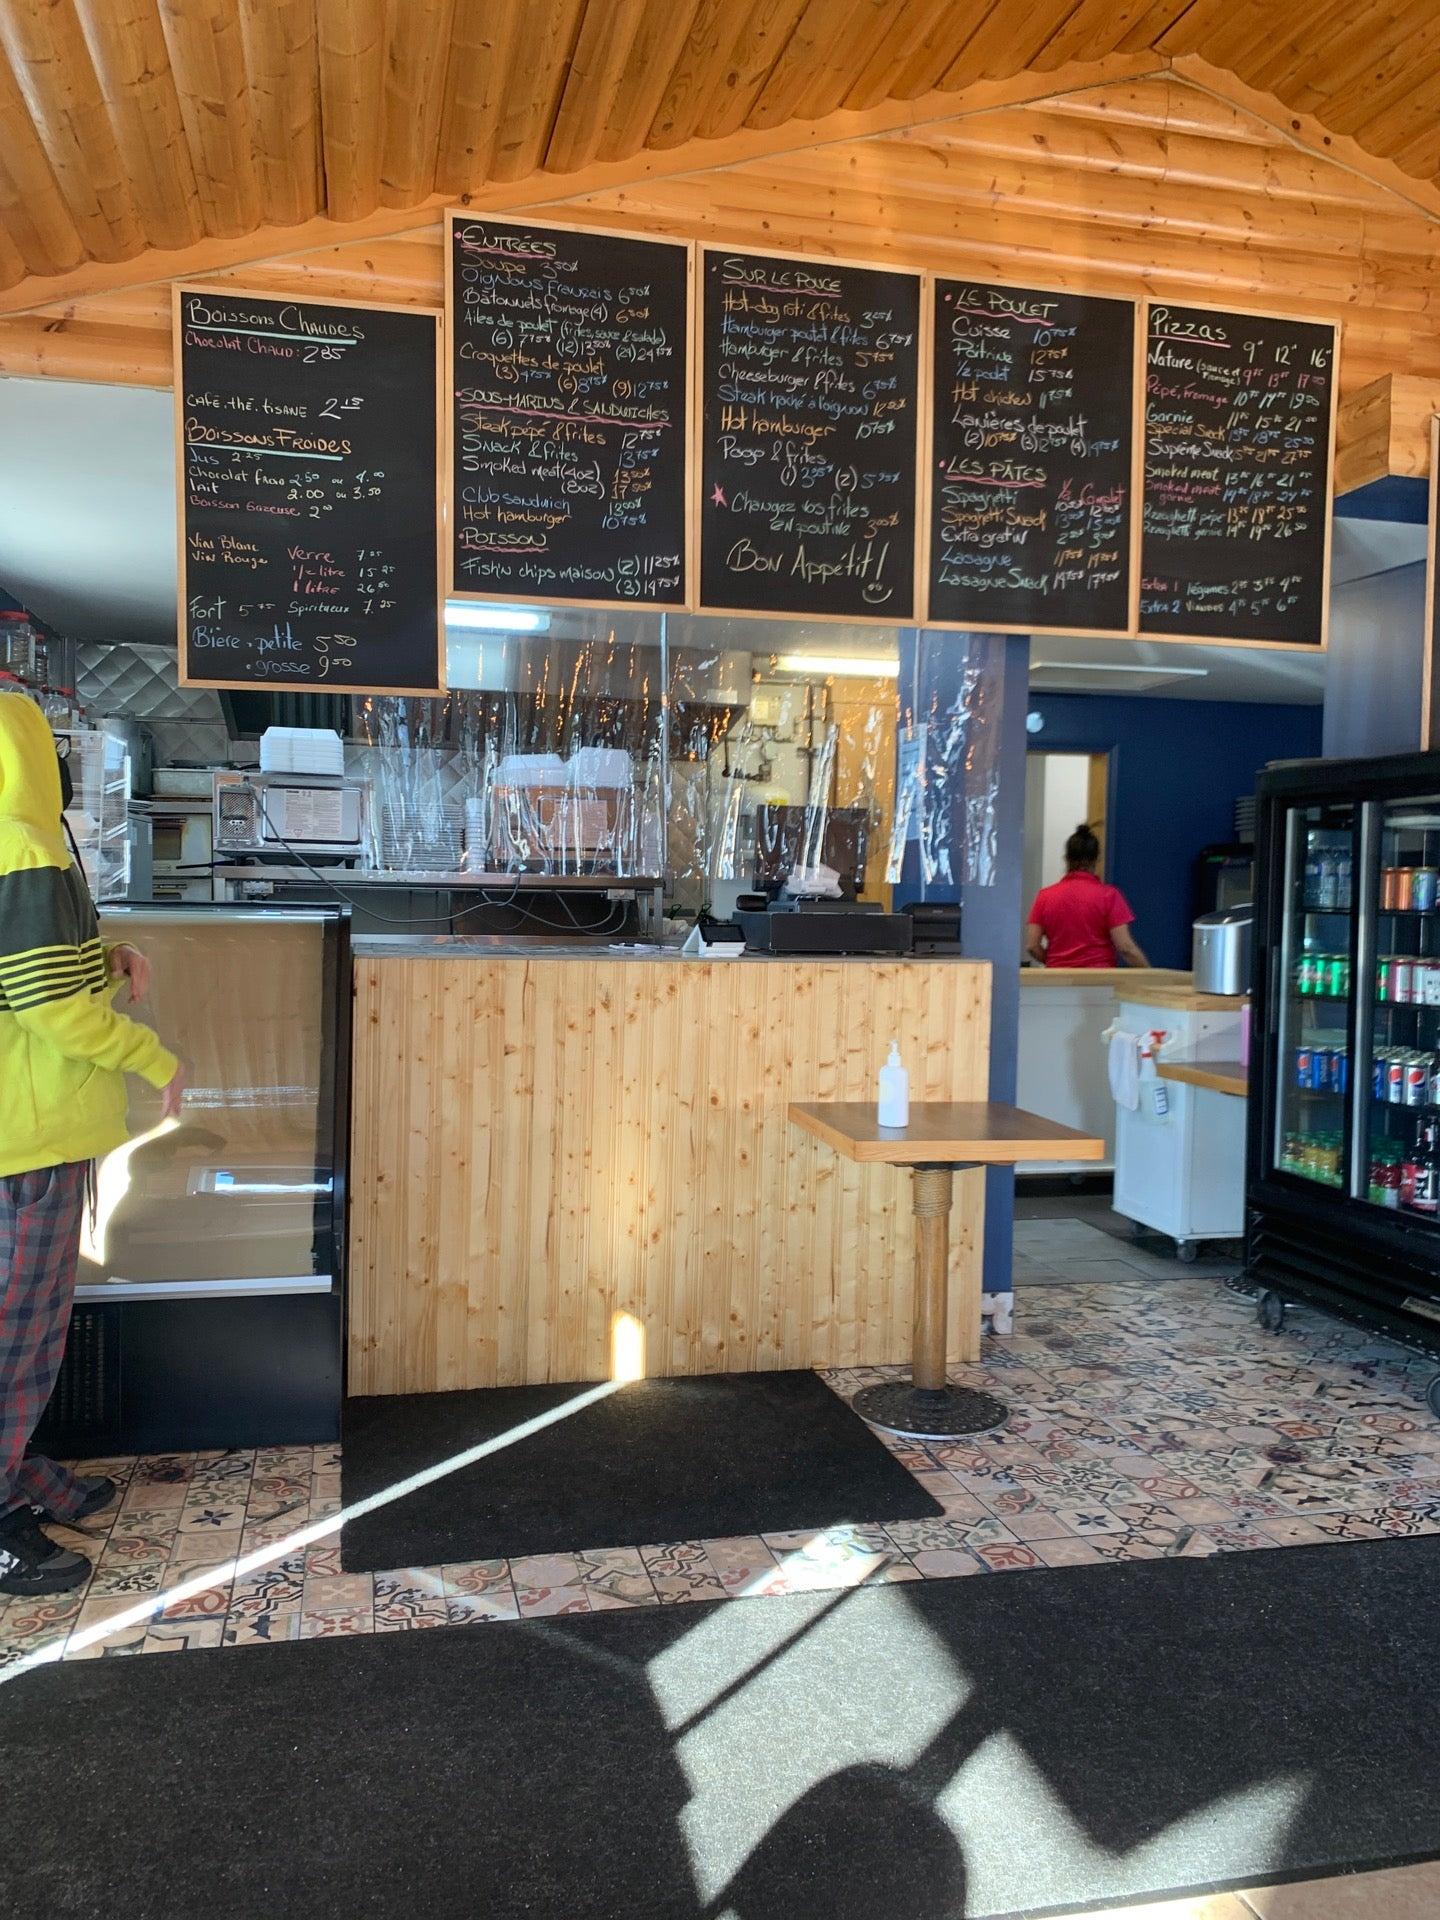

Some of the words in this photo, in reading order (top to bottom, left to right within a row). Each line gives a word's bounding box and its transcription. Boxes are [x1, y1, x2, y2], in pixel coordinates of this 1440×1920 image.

[461, 225, 557, 257] ENTRÉES
[461, 250, 526, 274] Soupe
[722, 258, 766, 284] SUR
[771, 271, 791, 286] LE
[794, 272, 842, 292] POUCE
[187, 299, 275, 325] Boissons
[544, 294, 590, 325] fromage
[591, 303, 608, 323] (4)
[722, 288, 779, 323] Hot-dog
[819, 302, 850, 323] frites
[957, 289, 982, 306] LE
[987, 290, 1059, 318] POULET
[464, 306, 494, 327] Ailes
[497, 313, 513, 328] de
[518, 315, 558, 334] poulet
[721, 314, 788, 344] Hamburger
[840, 326, 868, 346] frites
[951, 316, 1011, 339] Cuisse
[1150, 307, 1227, 341] Pizzas
[491, 329, 513, 350] (6)
[556, 338, 579, 358] (12)
[719, 335, 789, 366] Hamburger
[803, 346, 844, 367] frites
[1147, 341, 1194, 369] Nature
[460, 342, 536, 367] Croquettes
[542, 352, 559, 369] de
[562, 355, 605, 375] poulet
[495, 365, 519, 383] (3)
[557, 375, 578, 395] (6)
[612, 380, 632, 399] (9)
[718, 362, 810, 393] Cheeseburger
[822, 369, 856, 393] frites
[460, 387, 565, 412] SOUS-MARINS
[717, 384, 766, 403] Steak
[952, 381, 981, 403] Hot
[460, 413, 512, 434] Steak
[565, 422, 607, 445] frites
[720, 405, 748, 431] Hot
[752, 409, 836, 446] hamburger
[1027, 414, 1044, 434] de
[190, 447, 219, 465] Jus
[528, 439, 544, 458] &
[544, 441, 579, 462] frites
[717, 435, 764, 466] Pogo
[771, 440, 783, 462] &
[785, 441, 827, 468] frites
[964, 430, 984, 450] (2)
[1021, 434, 1038, 453] (3)
[1070, 440, 1087, 458] (4)
[189, 466, 248, 482] Chocolat
[331, 477, 343, 485] ou
[462, 455, 526, 476] Smoked
[780, 466, 797, 487] (1)
[835, 465, 858, 492] (2)
[947, 455, 985, 475] LES
[989, 459, 1048, 483] PÂTES
[288, 489, 324, 500] 2.00
[336, 490, 346, 498] ou
[353, 487, 381, 499] 3.50
[462, 487, 500, 503] Club
[503, 492, 570, 514] sandwich
[561, 482, 604, 500] (8oz)
[462, 506, 491, 521] Hot
[497, 506, 572, 529] hamburger
[730, 492, 796, 522] Changez
[828, 493, 870, 521] frites
[463, 527, 546, 547] POISSON
[940, 526, 979, 543] Extra
[223, 552, 268, 569] Rouge
[288, 547, 335, 564] Verre
[519, 562, 557, 585] chips
[559, 566, 615, 582] maison
[617, 554, 640, 577] (2)
[615, 580, 640, 597] (3)
[190, 596, 226, 620] Fort
[1172, 600, 1181, 614] 2
[258, 622, 302, 655] petite
[254, 662, 310, 676] grosse
